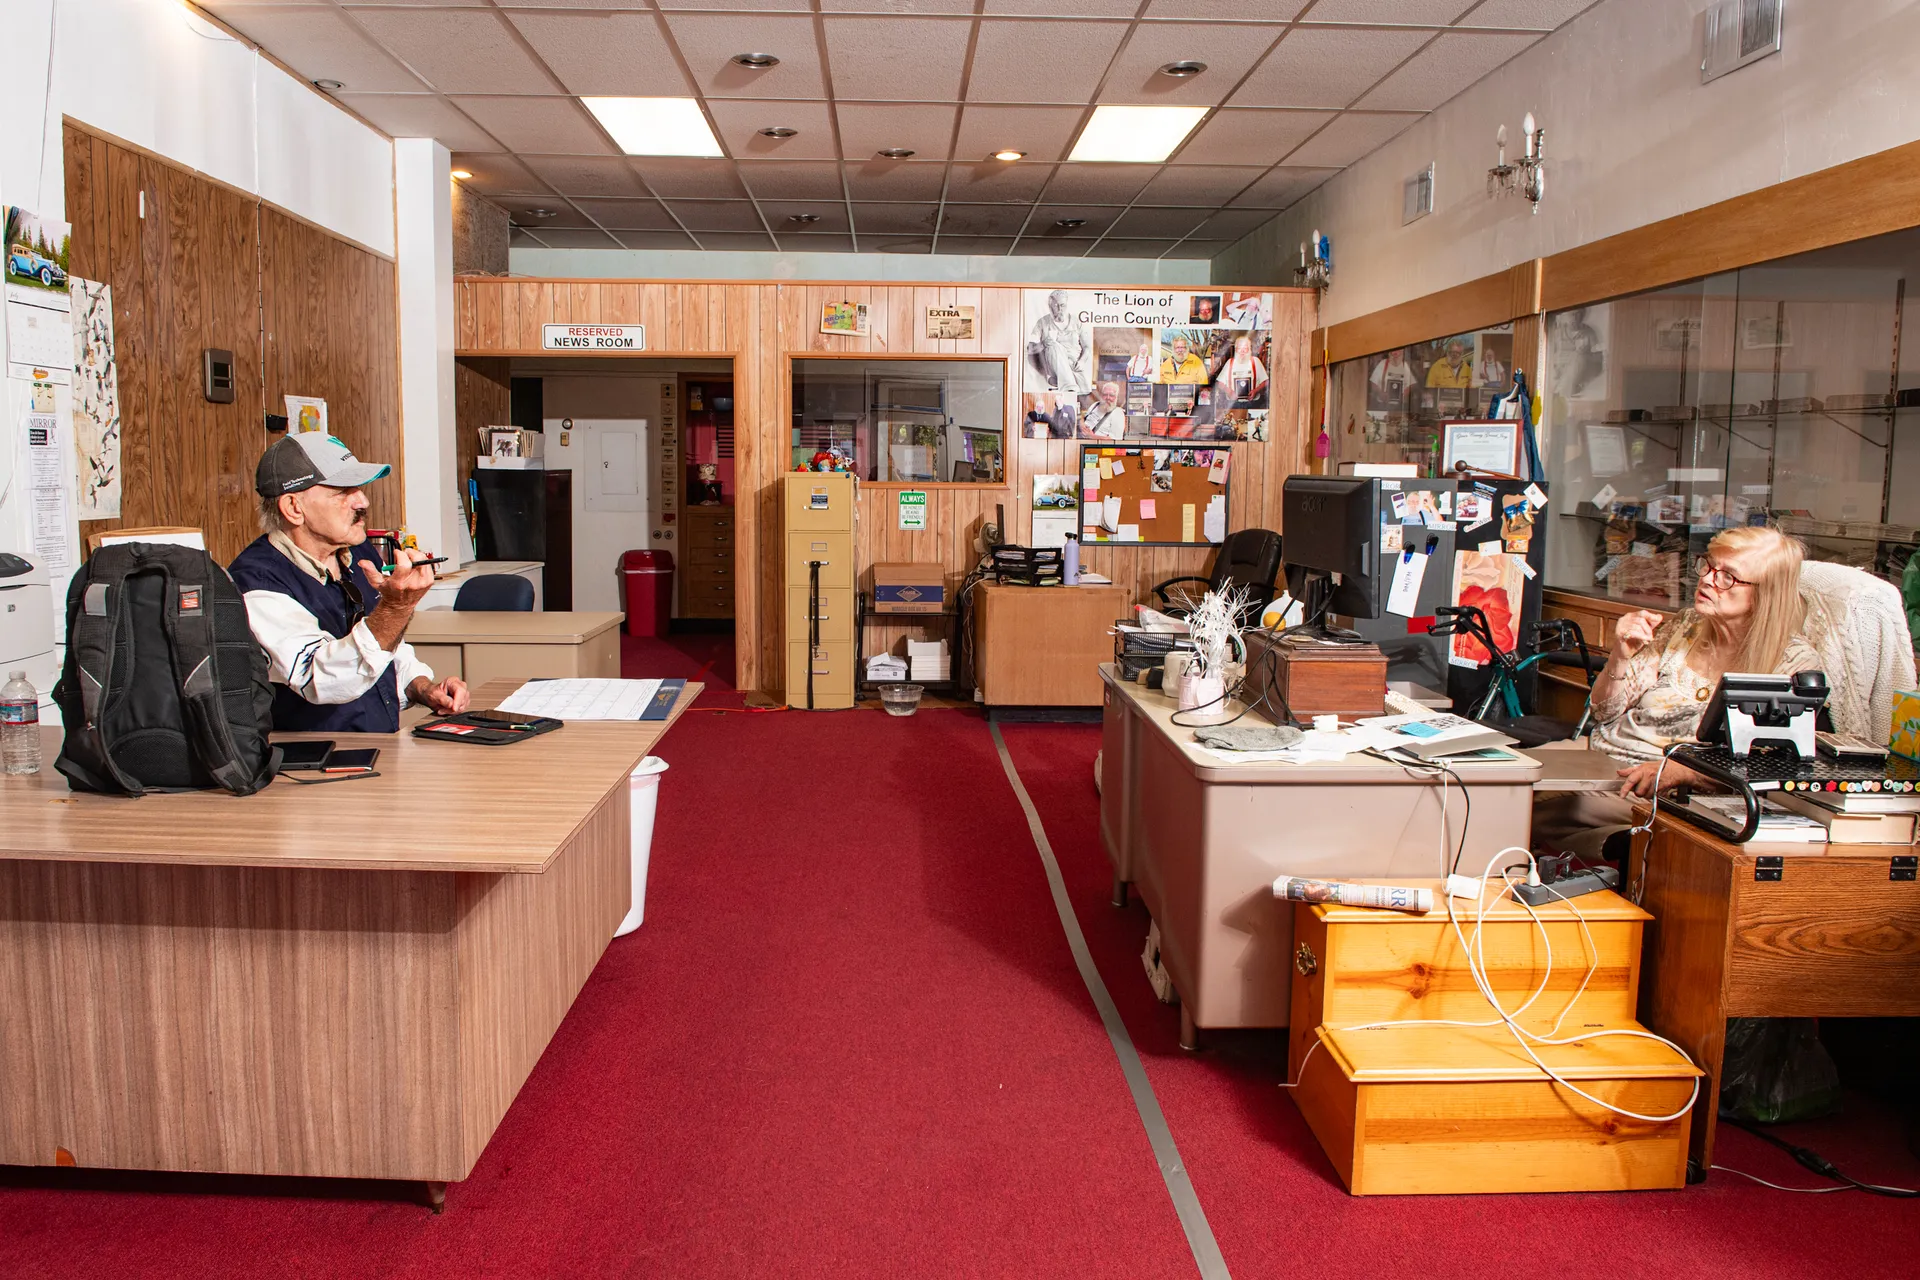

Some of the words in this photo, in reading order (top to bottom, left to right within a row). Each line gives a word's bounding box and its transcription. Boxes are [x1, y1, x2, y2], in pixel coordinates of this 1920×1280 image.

[1094, 293, 1120, 305] The
[1125, 294, 1154, 306] Lion
[1159, 294, 1174, 307] of
[1078, 311, 1119, 323] Glenn
[1124, 312, 1187, 328] County...
[568, 328, 623, 336] RESERVED
[554, 338, 590, 347] NEWS
[596, 338, 633, 347] ROOM
[29, 418, 57, 428] MIRROR
[1450, 657, 1478, 668] MIRROR
